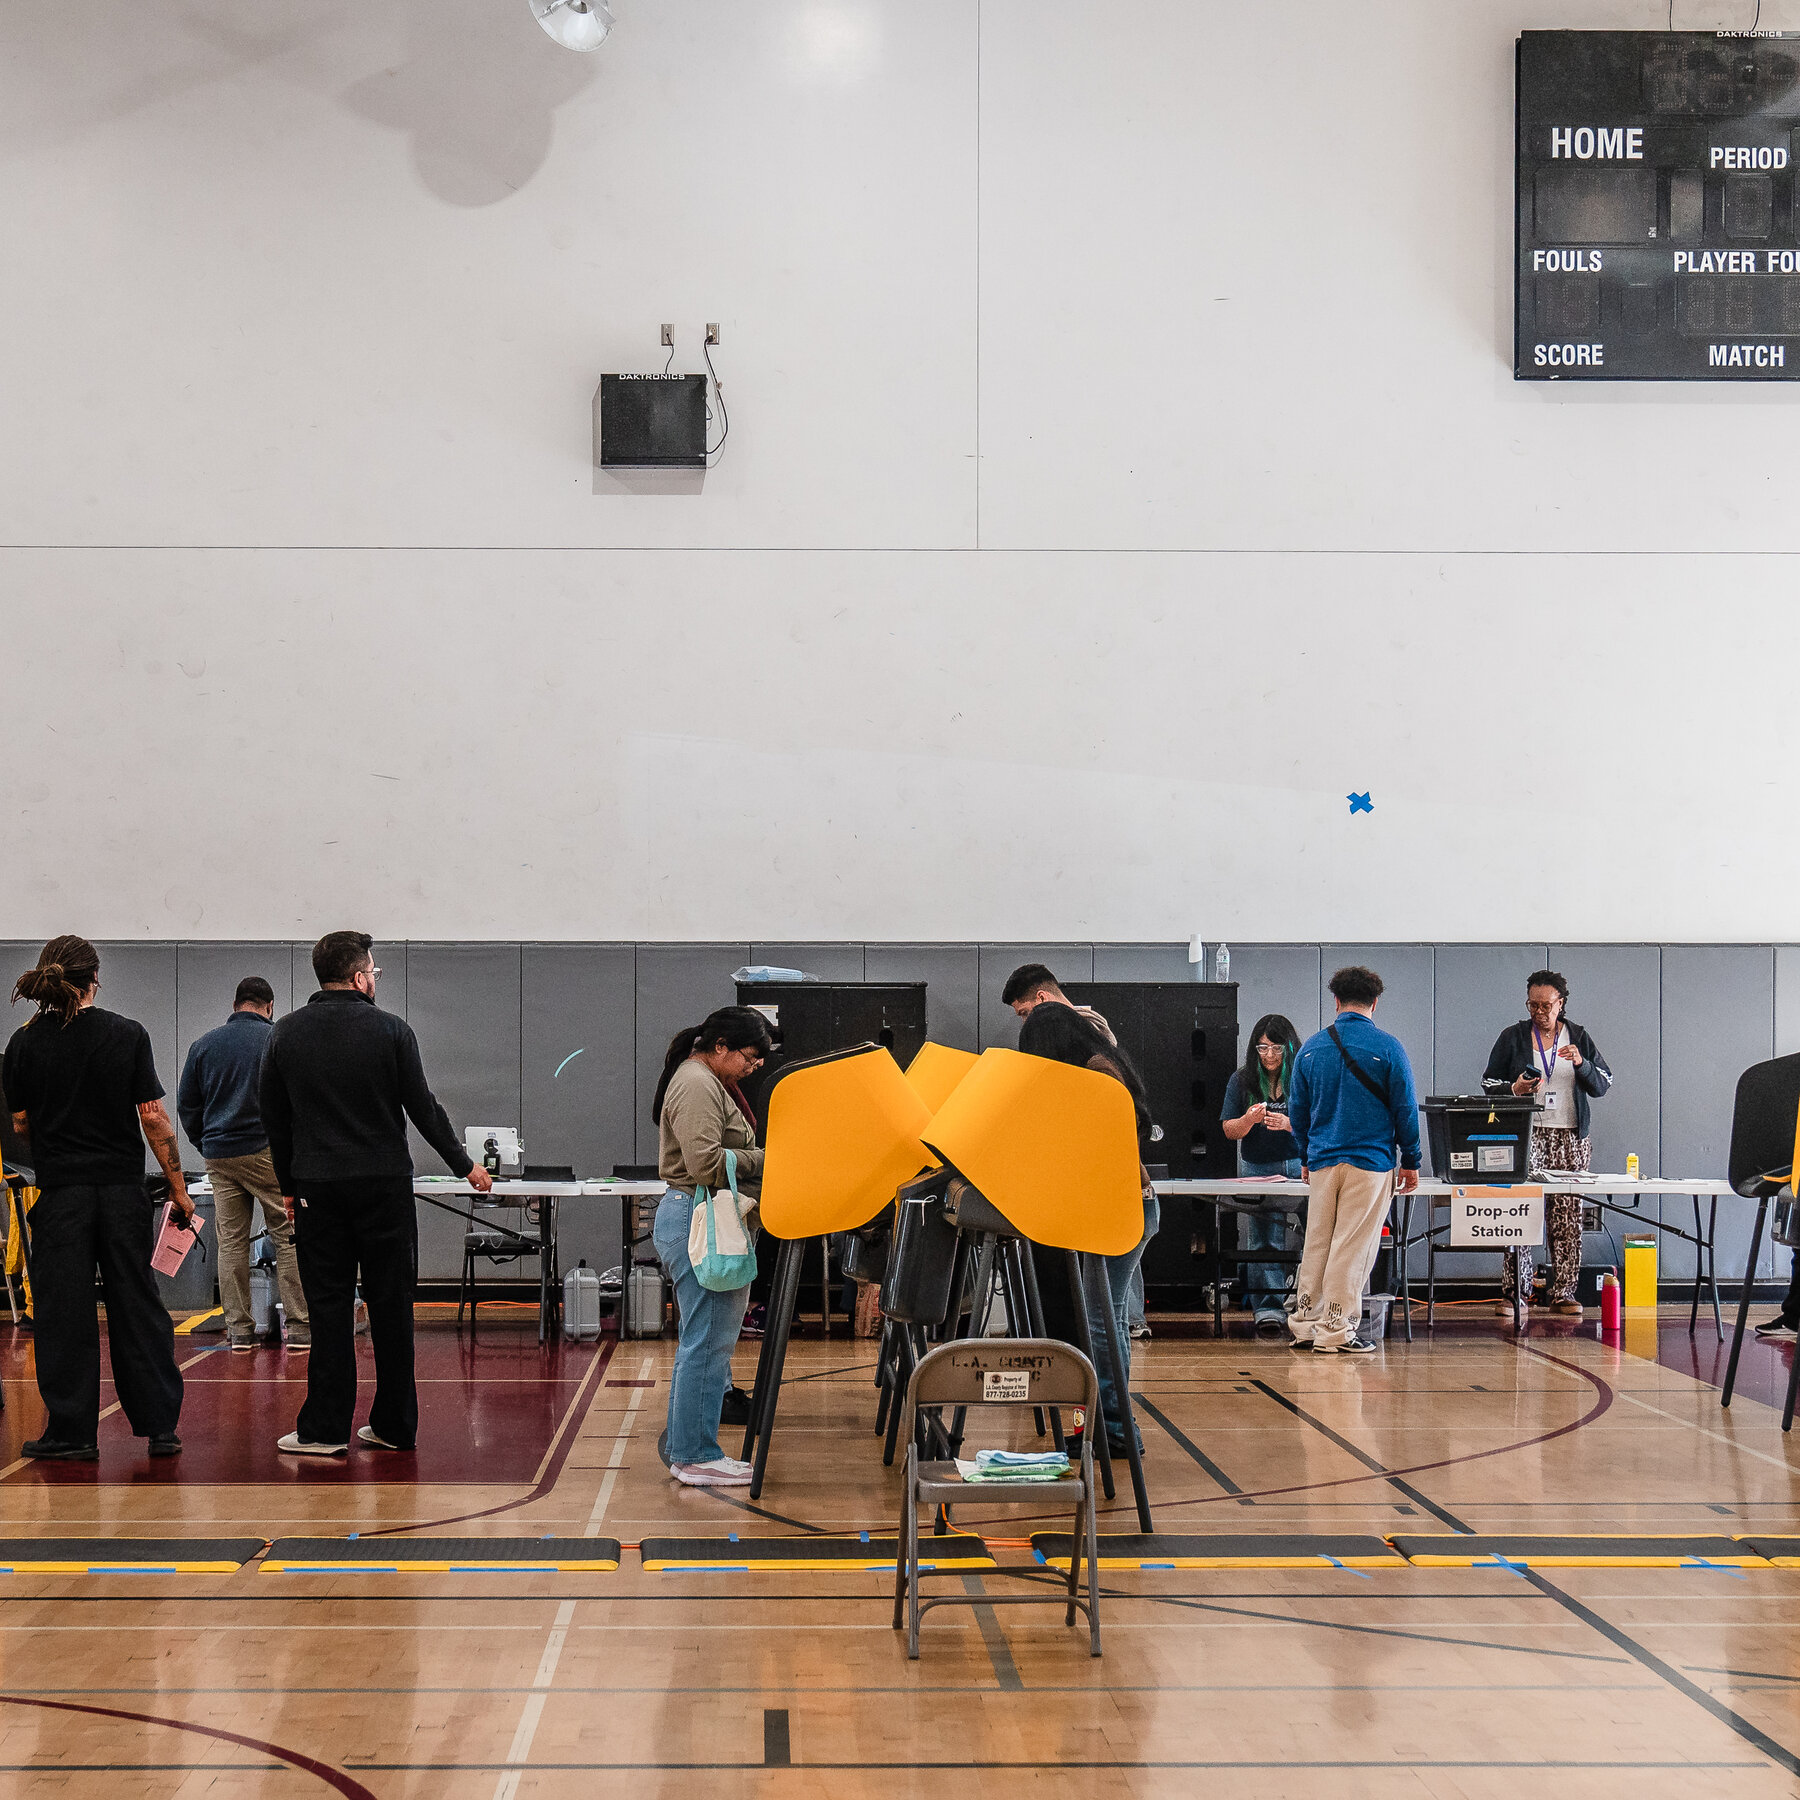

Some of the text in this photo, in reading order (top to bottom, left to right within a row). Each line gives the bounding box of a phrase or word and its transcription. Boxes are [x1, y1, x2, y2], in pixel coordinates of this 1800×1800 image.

[1552, 127, 1643, 159] HOME
[1710, 147, 1787, 169] PERIOD
[1533, 250, 1602, 272] FOULS
[1673, 251, 1756, 273] PLAYER
[1533, 344, 1604, 366] SCORE
[1709, 345, 1784, 367] MATCH
[1465, 1203, 1530, 1220] Drop-off
[1471, 1224, 1523, 1237] Station
